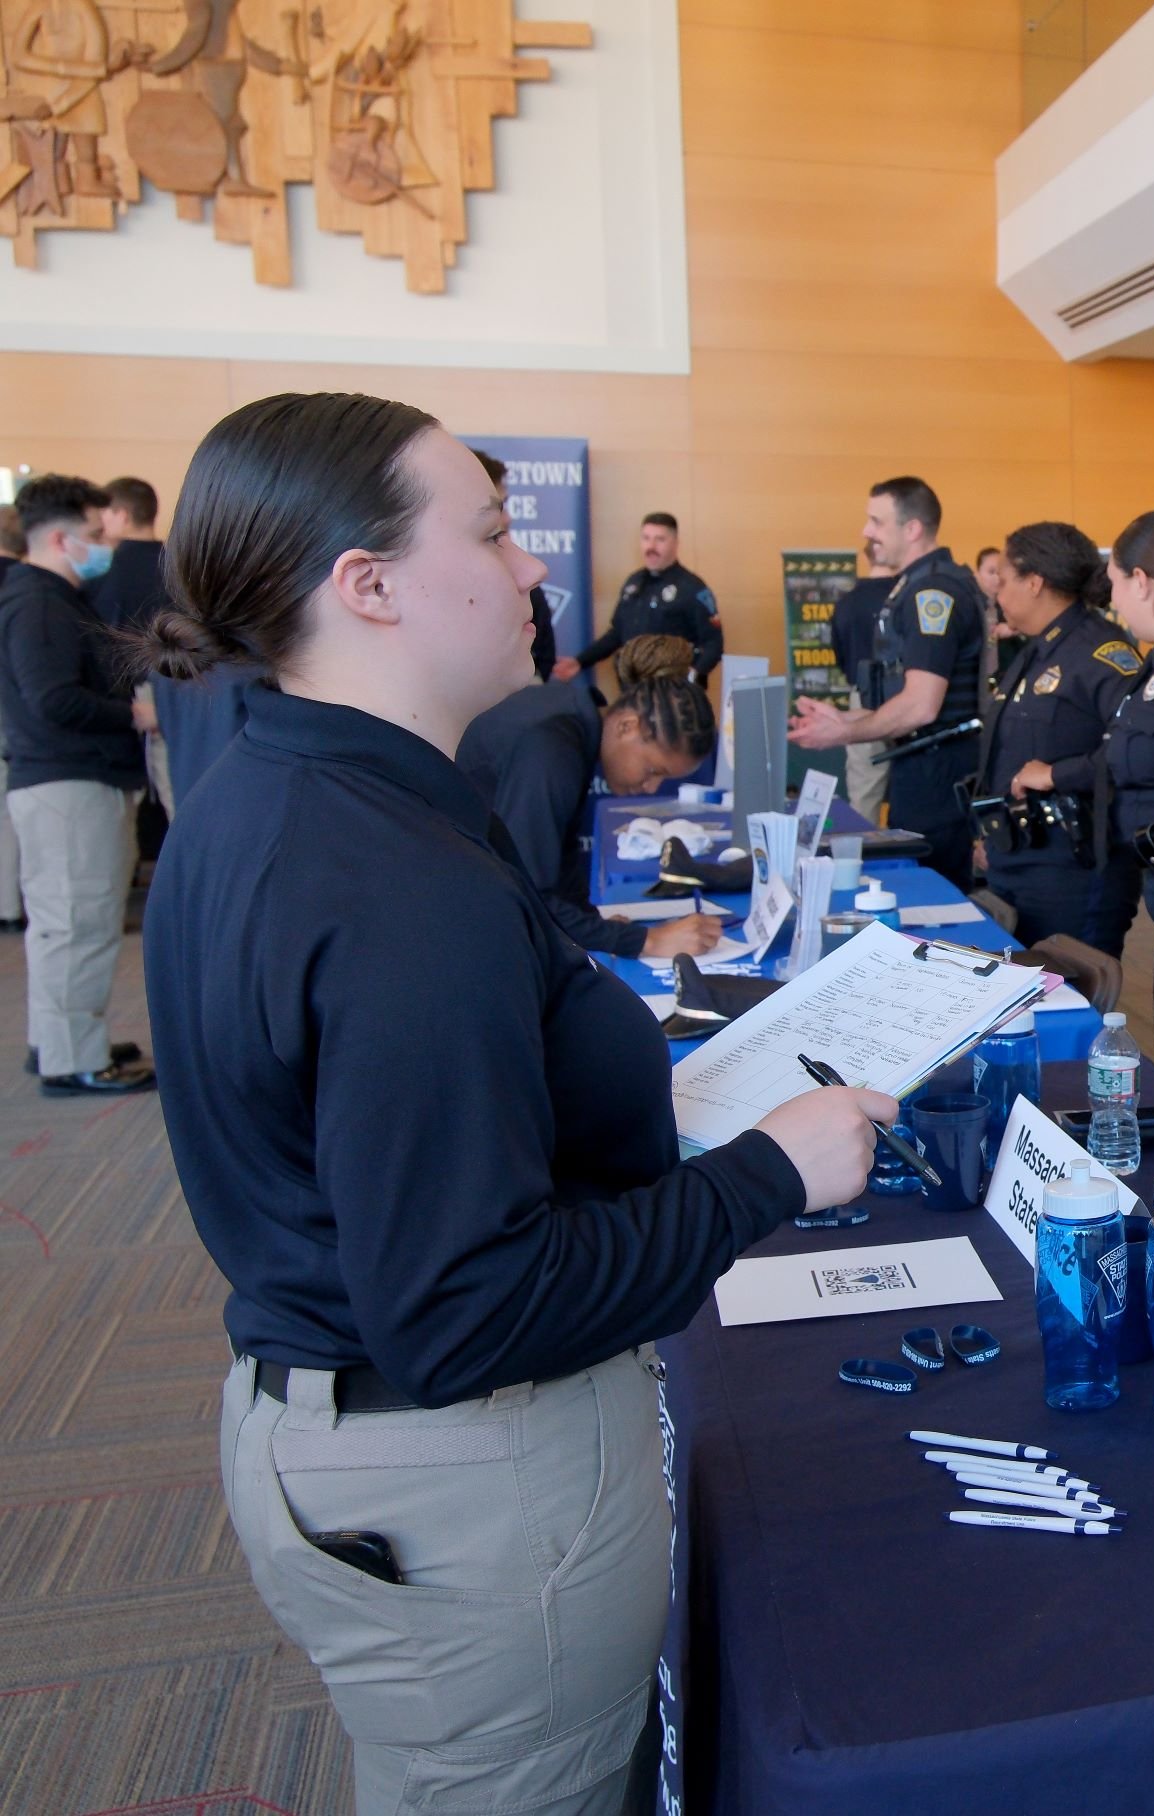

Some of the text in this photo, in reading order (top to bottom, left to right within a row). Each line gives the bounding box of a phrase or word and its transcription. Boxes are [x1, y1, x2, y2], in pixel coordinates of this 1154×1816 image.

[504, 461, 583, 487] ETOWN
[506, 495, 537, 520] CE
[509, 529, 576, 554] MENT
[1014, 1124, 1066, 1185] Massach
[1008, 1179, 1038, 1235] State
[871, 1379, 912, 1392] 508-820-2292
